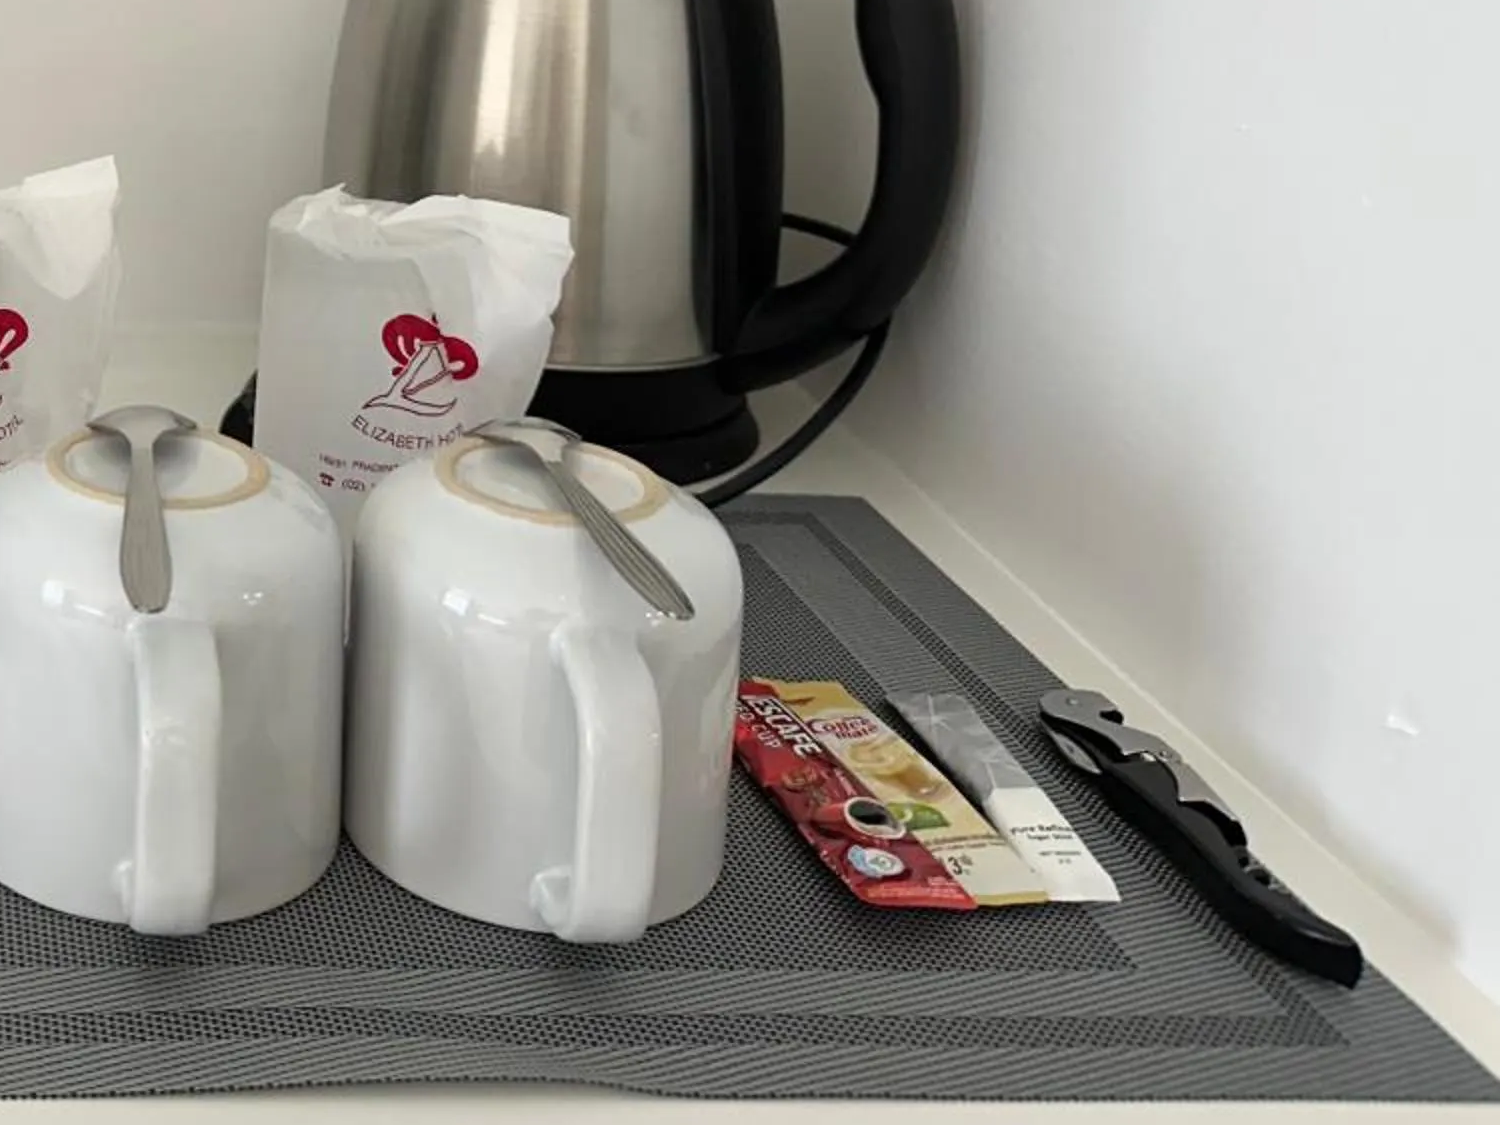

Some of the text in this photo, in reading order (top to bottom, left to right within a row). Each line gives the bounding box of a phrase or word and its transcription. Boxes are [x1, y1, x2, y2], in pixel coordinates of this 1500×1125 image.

[351, 415, 434, 450] ELIZABETH
[751, 724, 782, 748] CUP
[947, 856, 963, 876] 3
